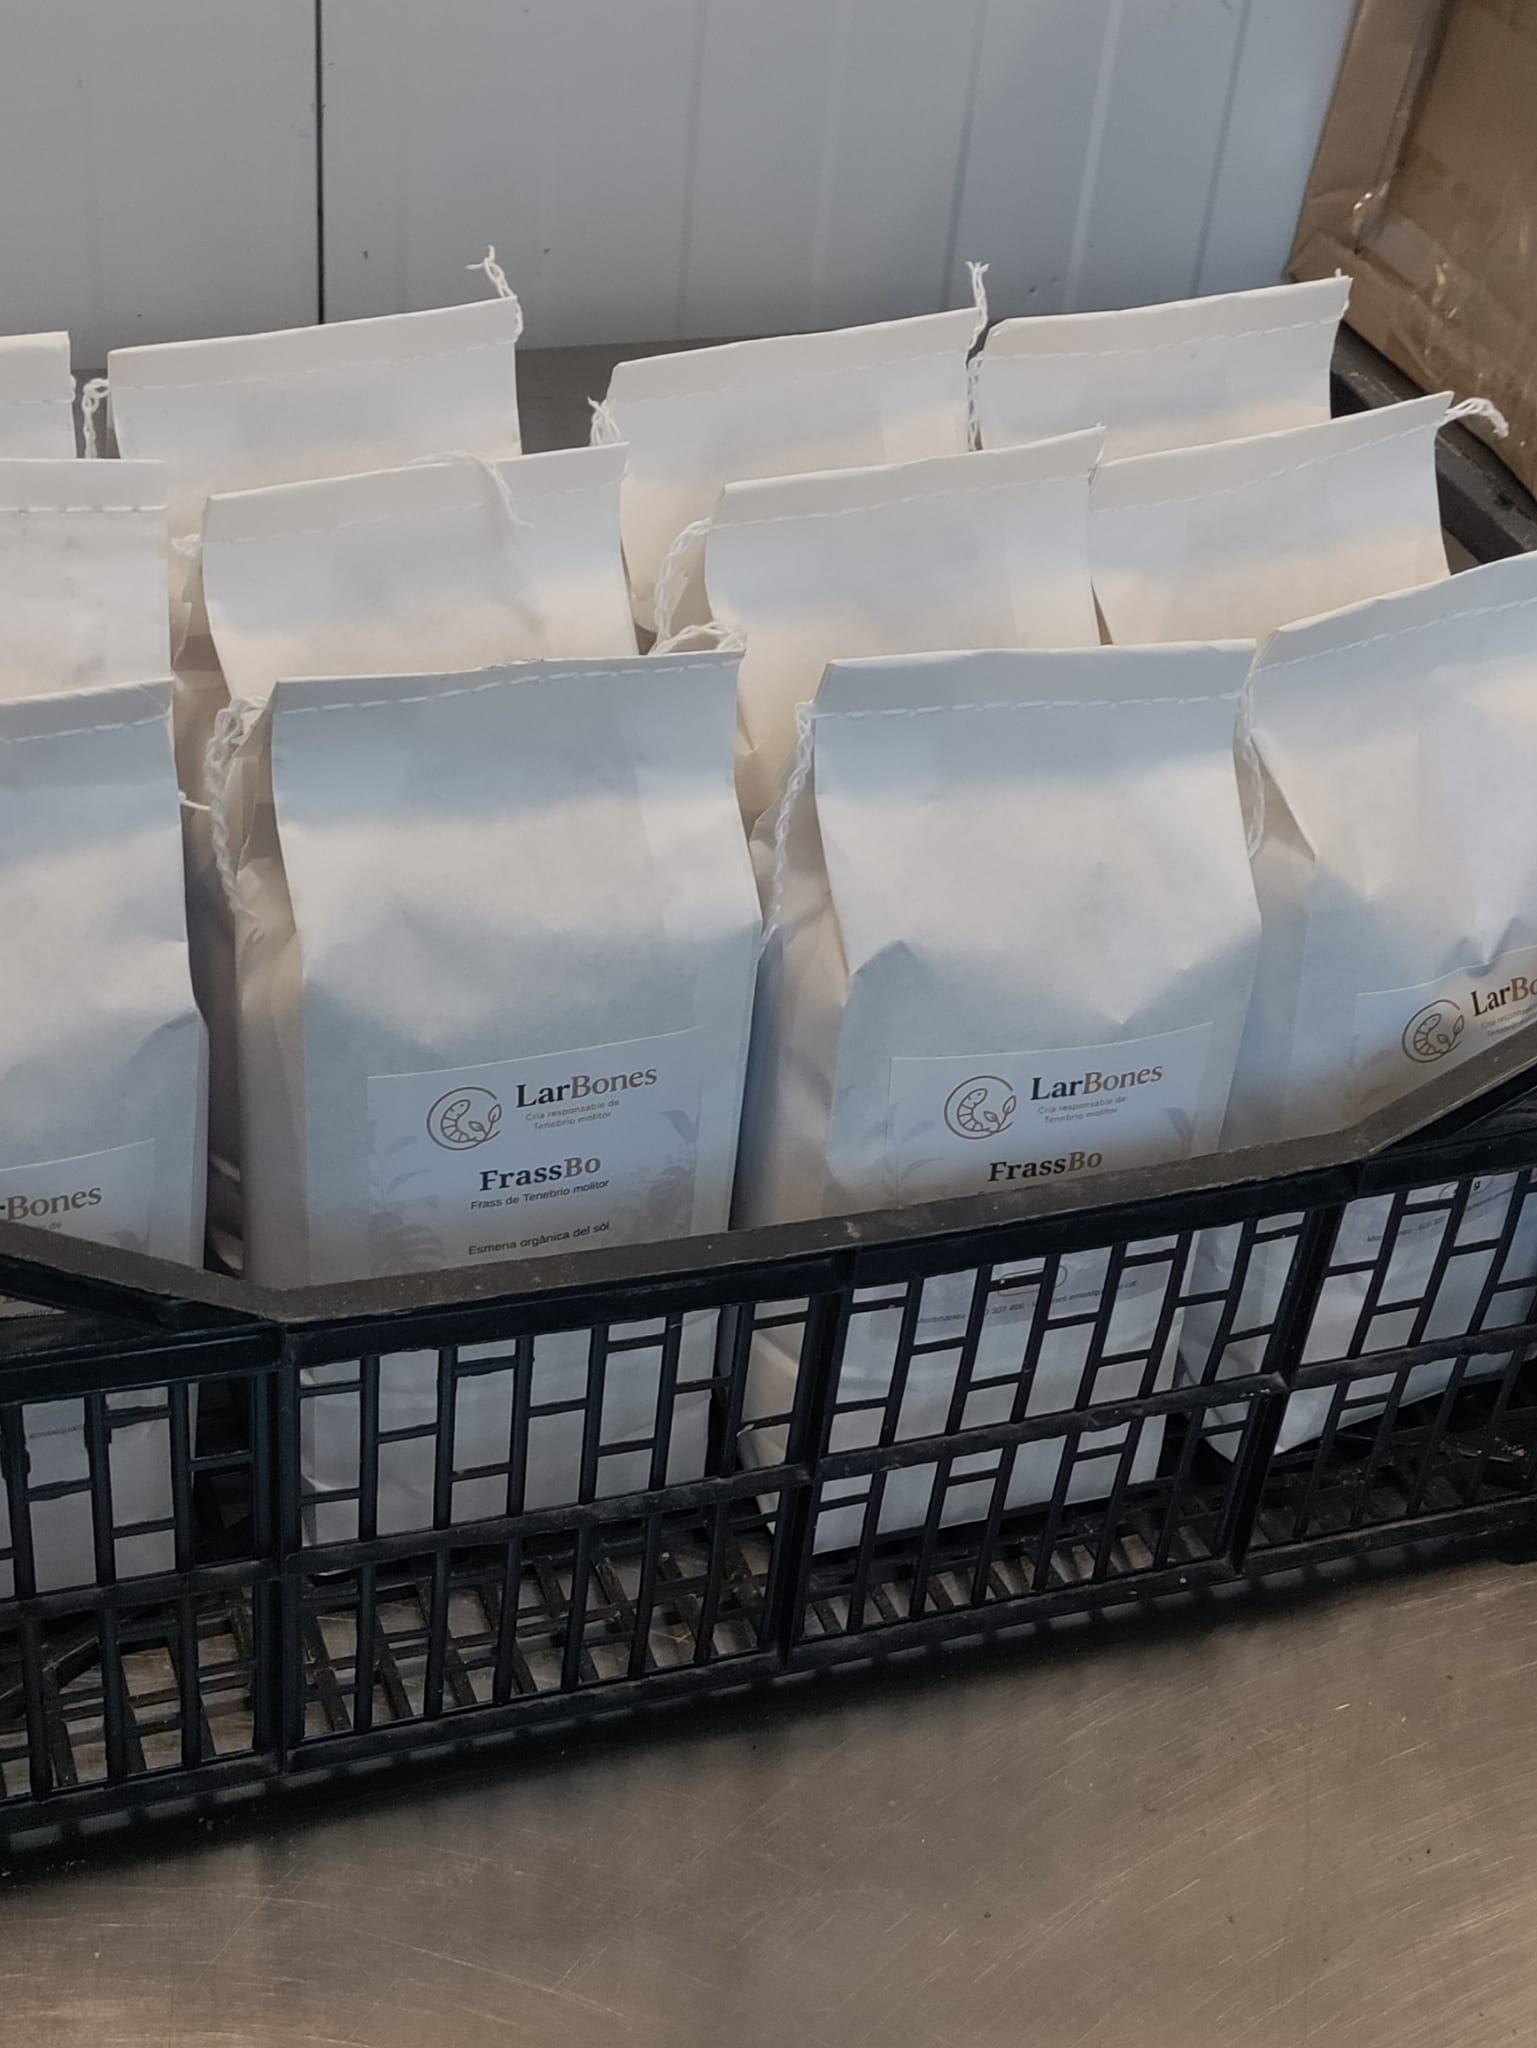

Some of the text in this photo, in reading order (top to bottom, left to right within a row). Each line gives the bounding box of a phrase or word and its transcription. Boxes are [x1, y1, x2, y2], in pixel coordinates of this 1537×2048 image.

[515, 1067, 658, 1109] LarBones
[1030, 1064, 1163, 1101] LarBones
[534, 1111, 612, 1130] Tenebrio molitor
[547, 1103, 605, 1118] responsable
[607, 1099, 620, 1108] de
[479, 1157, 601, 1191] FrassBo
[987, 1151, 1103, 1182] FrassBo
[0, 1187, 103, 1220] Bones
[470, 1179, 610, 1210] Frass de Tenebrio molitor
[468, 1240, 517, 1255] Esmena
[520, 1231, 570, 1247] orgànica
[572, 1226, 591, 1238] del
